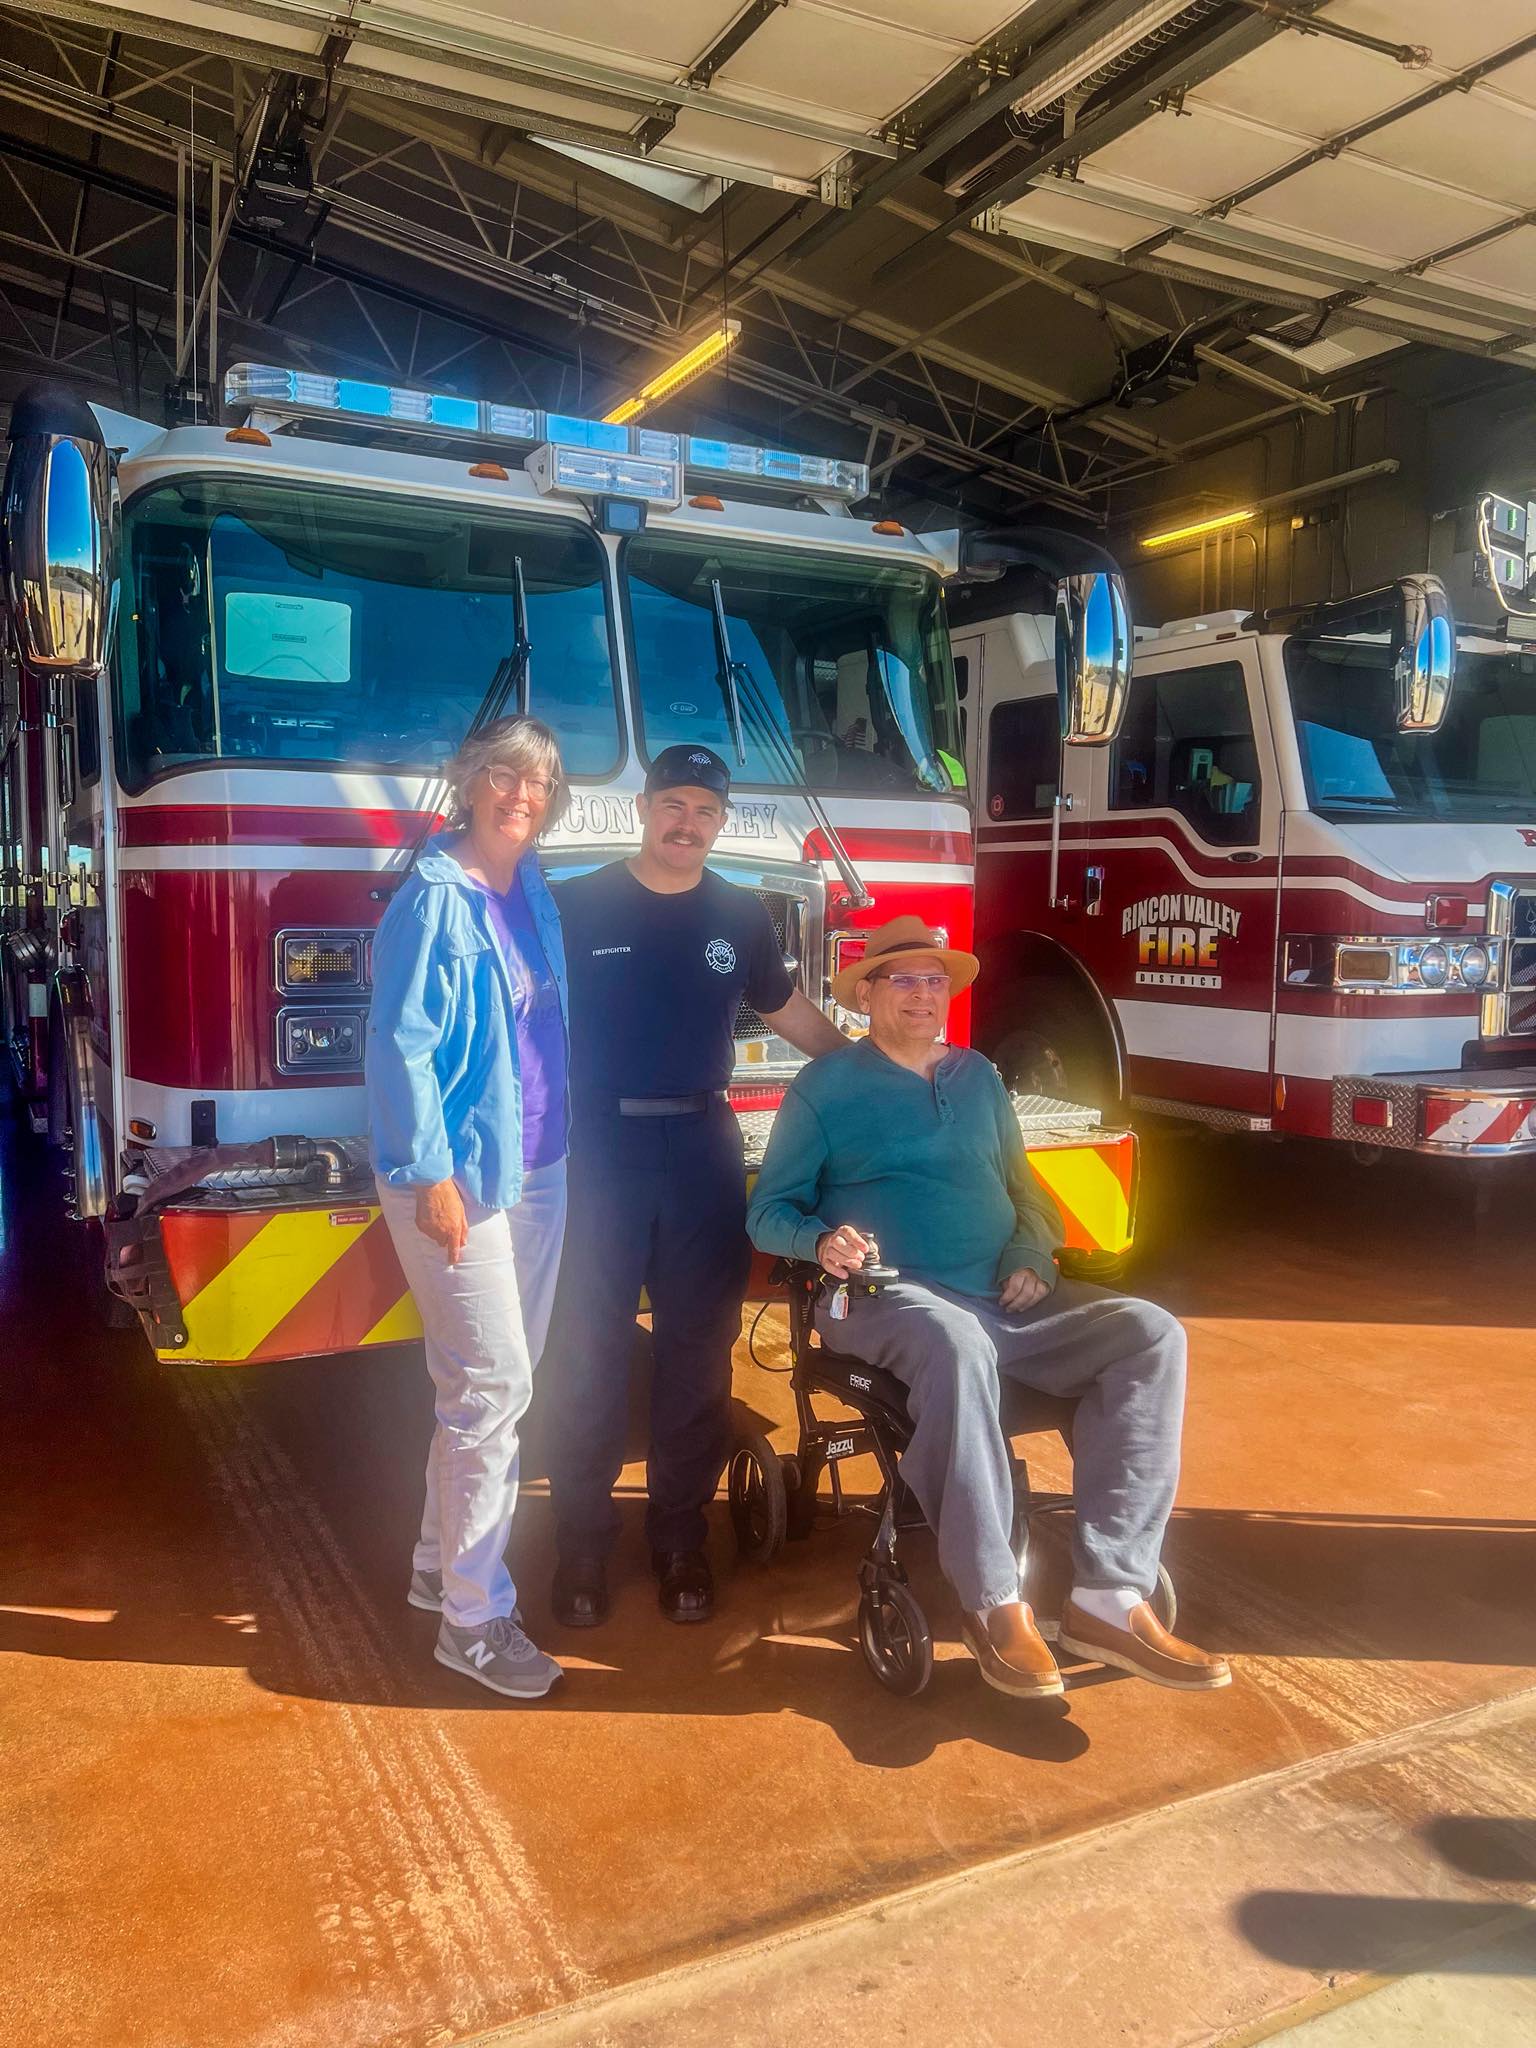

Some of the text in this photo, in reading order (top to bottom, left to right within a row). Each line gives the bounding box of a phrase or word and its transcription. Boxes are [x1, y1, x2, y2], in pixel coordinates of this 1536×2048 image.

[552, 795, 634, 833] CON
[1122, 894, 1241, 937] RINCON VALLEY
[592, 946, 631, 957] FIREFIGHTER
[1139, 926, 1219, 967] FIRE
[1140, 973, 1217, 986] DISTRICT
[826, 1438, 854, 1455] Jazzy
[465, 1640, 496, 1670] N
